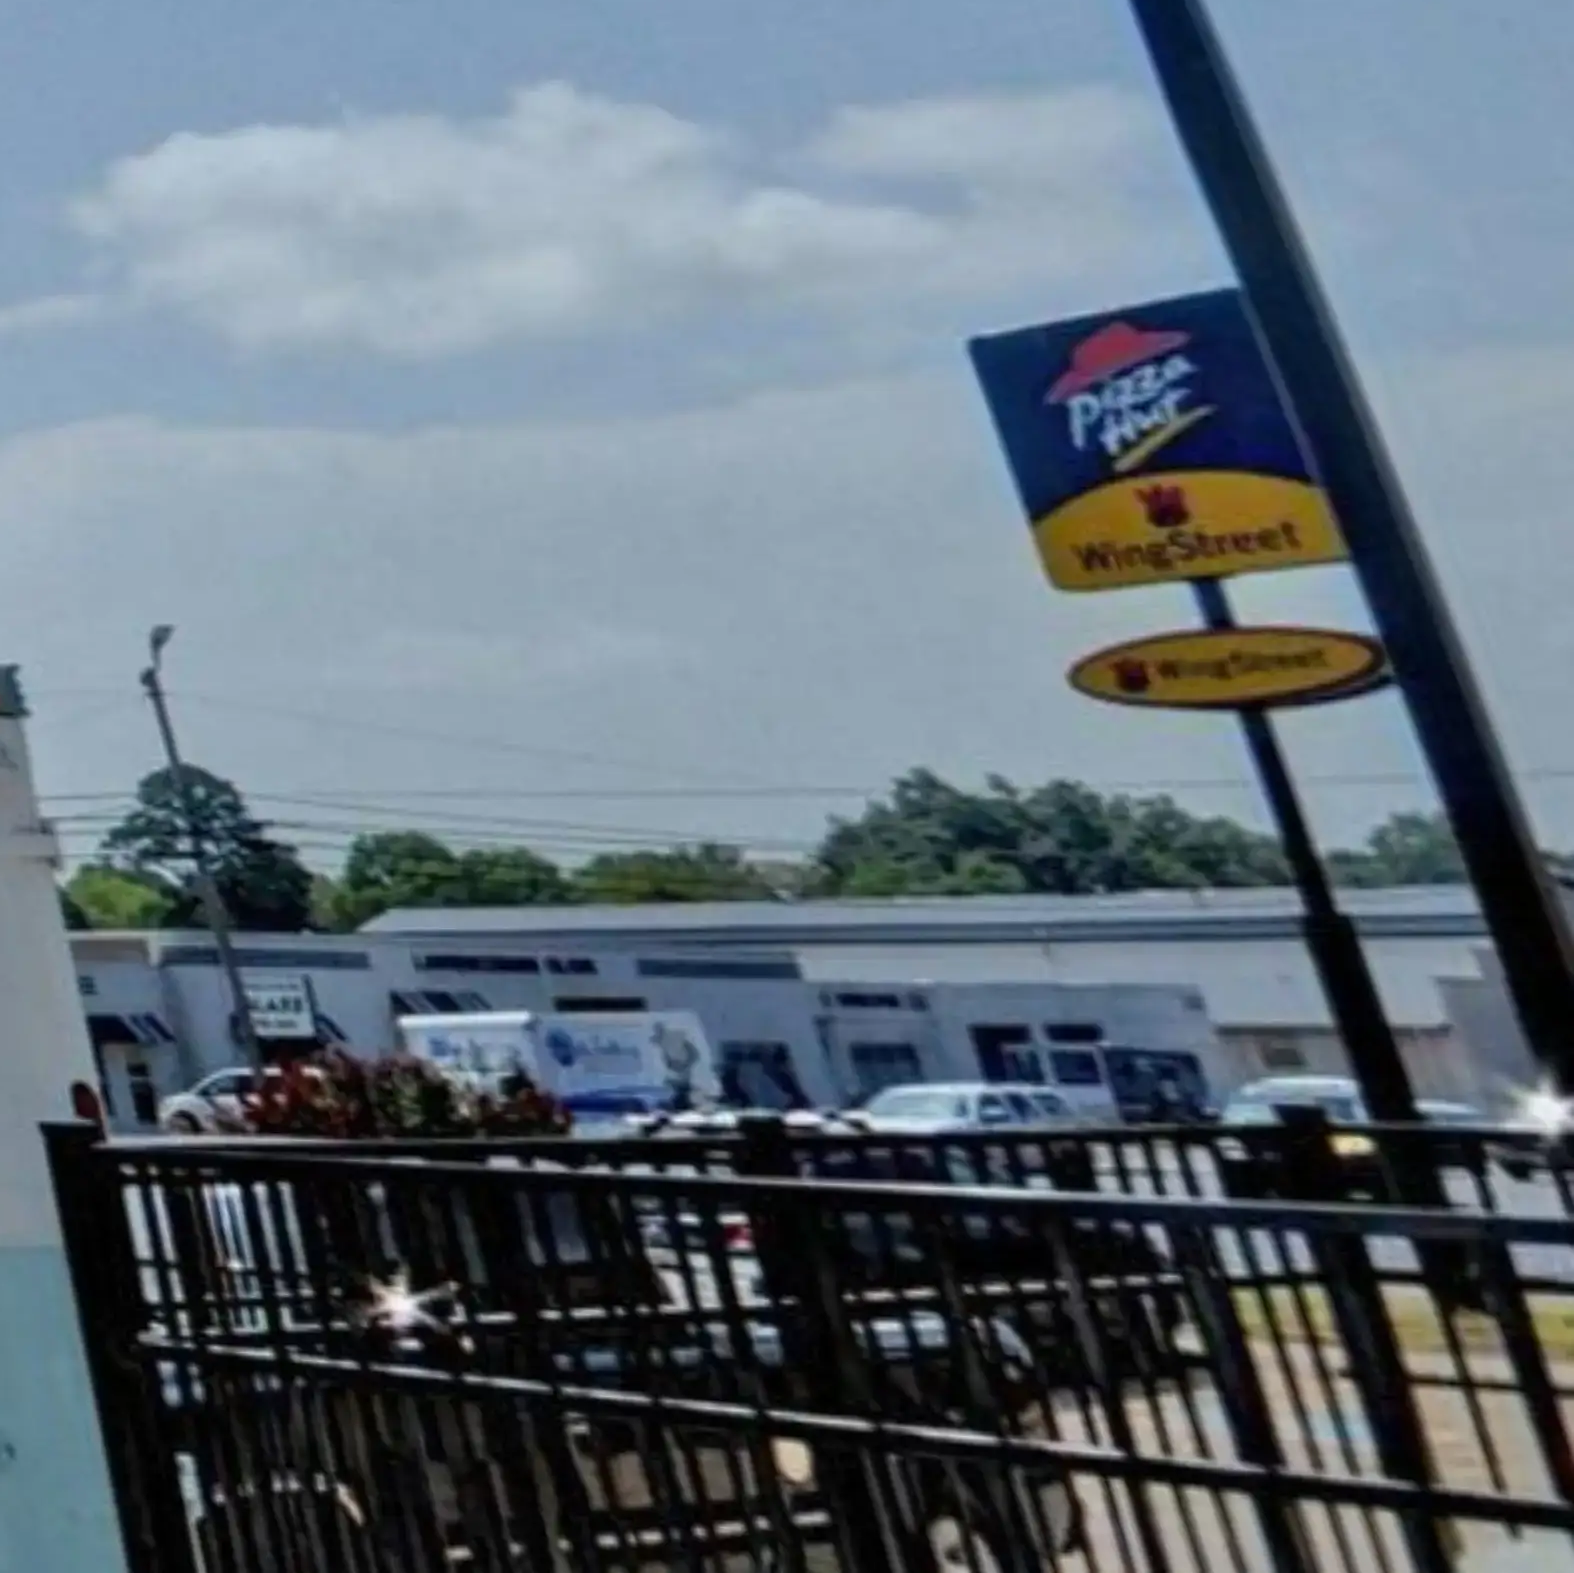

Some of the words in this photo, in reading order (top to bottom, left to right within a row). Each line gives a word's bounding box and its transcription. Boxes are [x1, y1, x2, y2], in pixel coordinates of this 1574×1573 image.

[1068, 353, 1198, 452] Pizza
[1099, 388, 1191, 457] Hut
[1070, 522, 1303, 573] WingStreet
